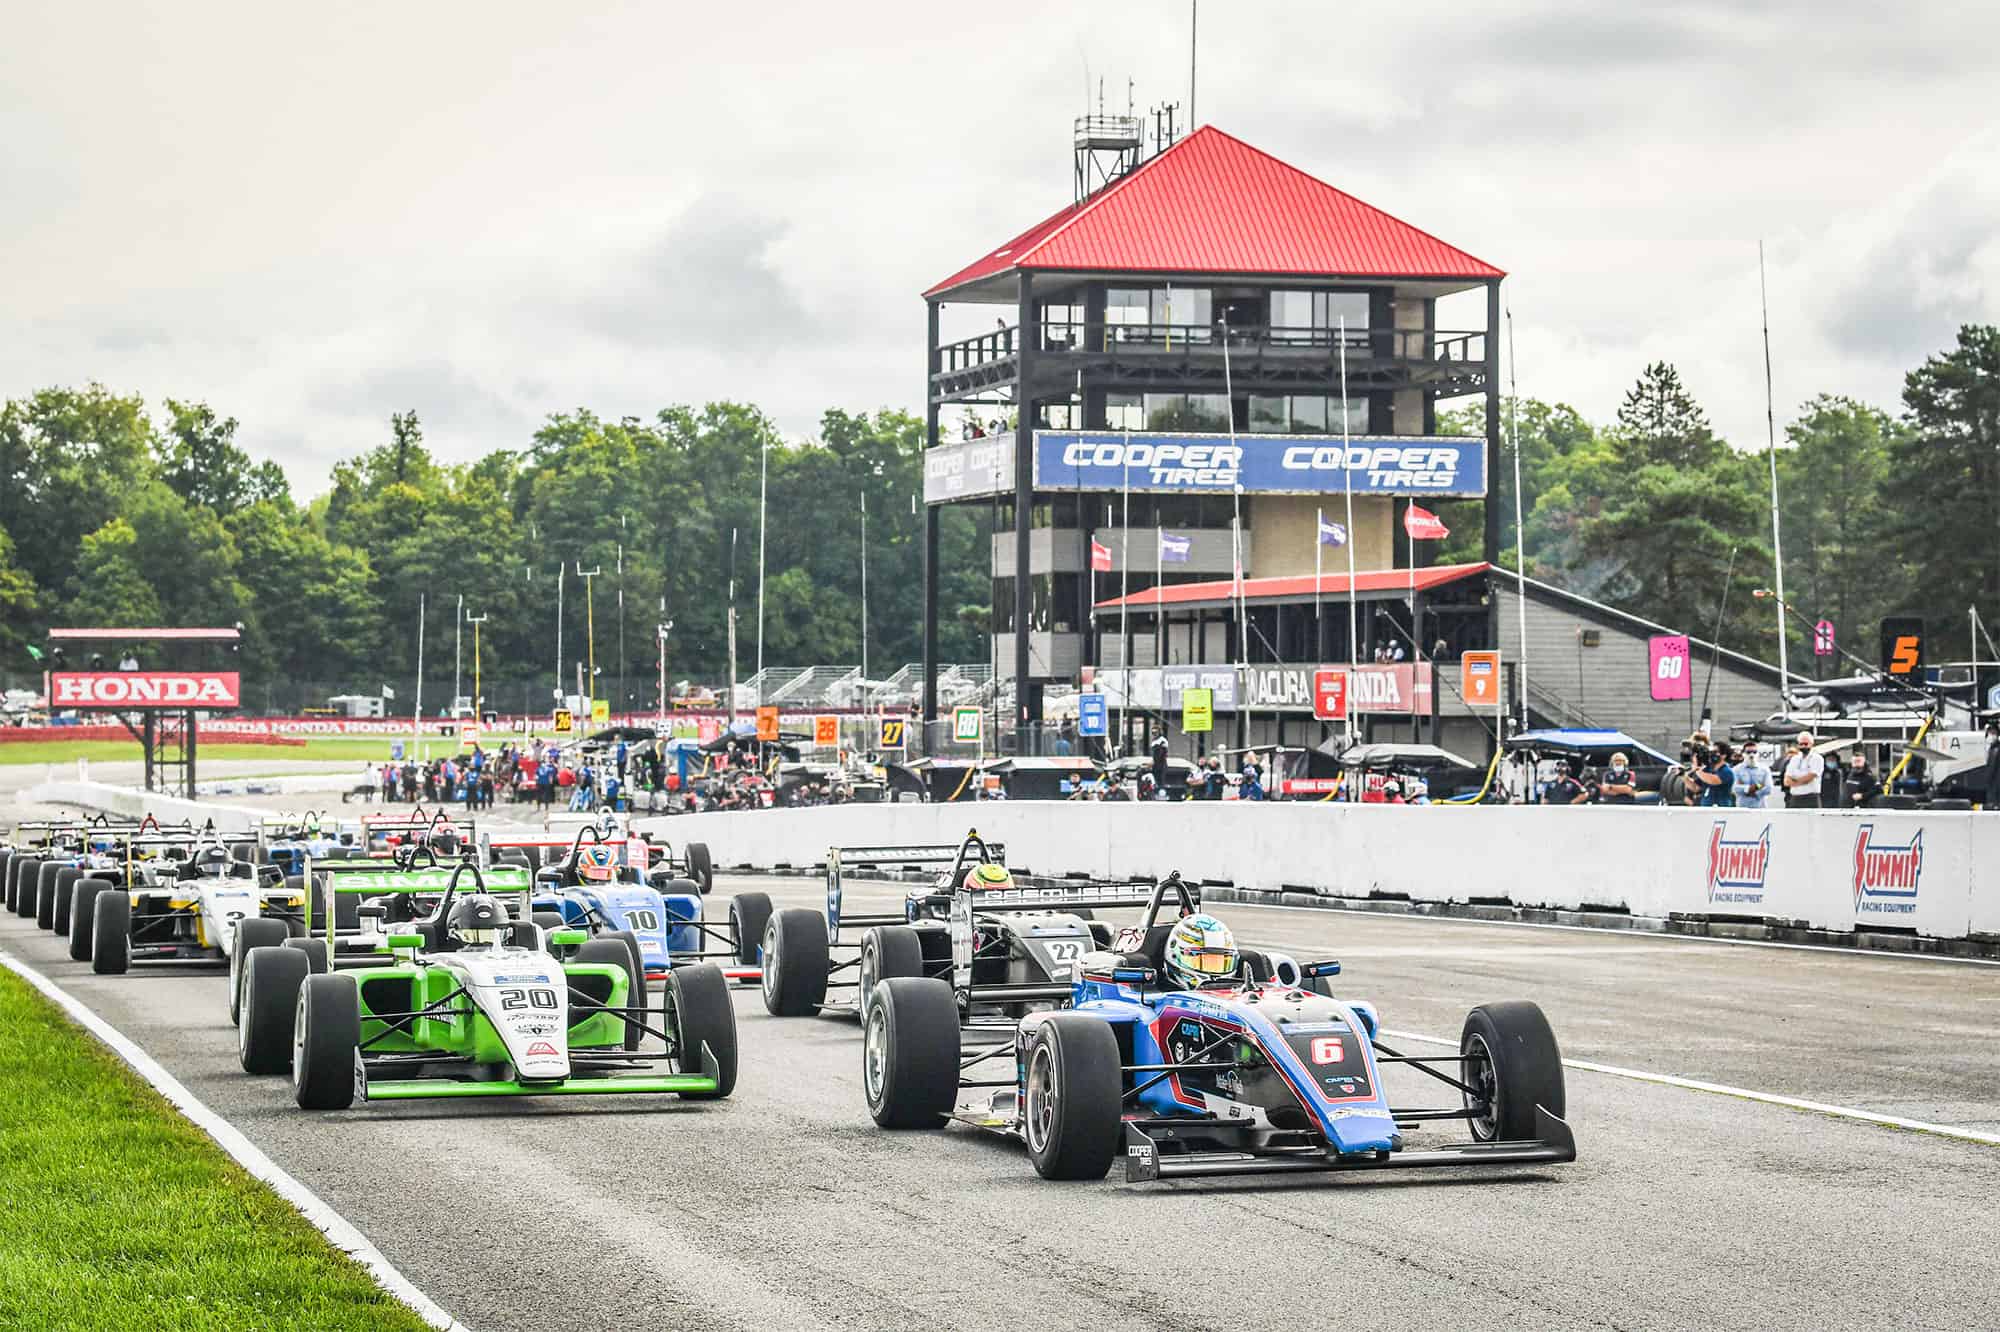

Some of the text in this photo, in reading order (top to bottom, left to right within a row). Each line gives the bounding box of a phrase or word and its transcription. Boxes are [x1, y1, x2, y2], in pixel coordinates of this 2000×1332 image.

[1063, 443, 1243, 468] COOPER
[1281, 446, 1460, 470] COOPER
[1150, 468, 1242, 485] TIRES
[1368, 471, 1459, 487] TIRES
[1890, 636, 1919, 673] 5
[1657, 655, 1683, 679] 60
[57, 678, 235, 701] HONDA
[1258, 670, 1311, 704] ACURA
[1348, 669, 1401, 703] ONDA
[1475, 679, 1485, 697] 9
[1326, 696, 1336, 711] 8
[199, 721, 268, 734] HONDA
[271, 721, 341, 734] HONDA
[344, 721, 416, 734] HONDA
[761, 716, 773, 733] 7
[882, 722, 904, 745] 27
[1709, 827, 1767, 888] SUMMIT
[1855, 831, 1919, 895] SUMMIT
[1714, 893, 1733, 903] RACING
[1862, 901, 1916, 913] RACING EQUIPMENT
[623, 911, 658, 930] 10
[1052, 943, 1079, 961] 22
[499, 988, 559, 1011] 20
[1311, 1037, 1344, 1065] 6
[1128, 1145, 1153, 1157] COOPER
